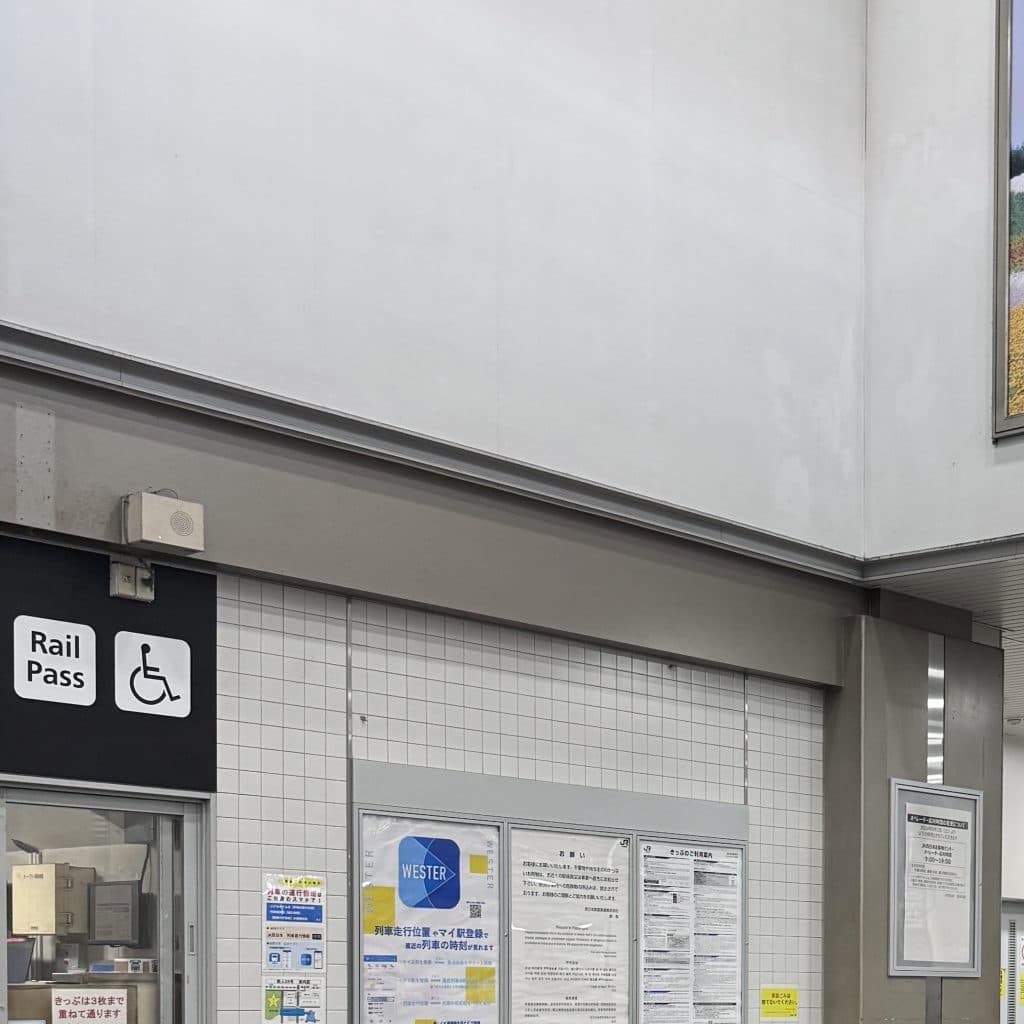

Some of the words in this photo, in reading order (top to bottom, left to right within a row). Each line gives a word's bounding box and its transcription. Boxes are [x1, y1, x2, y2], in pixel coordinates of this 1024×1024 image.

[31, 630, 80, 659] Rail
[27, 660, 85, 689] Pass
[402, 864, 447, 880] WESTER
[55, 996, 124, 1006] きっぷは3枚まで
[58, 1009, 121, 1019] 重ねて通ります
